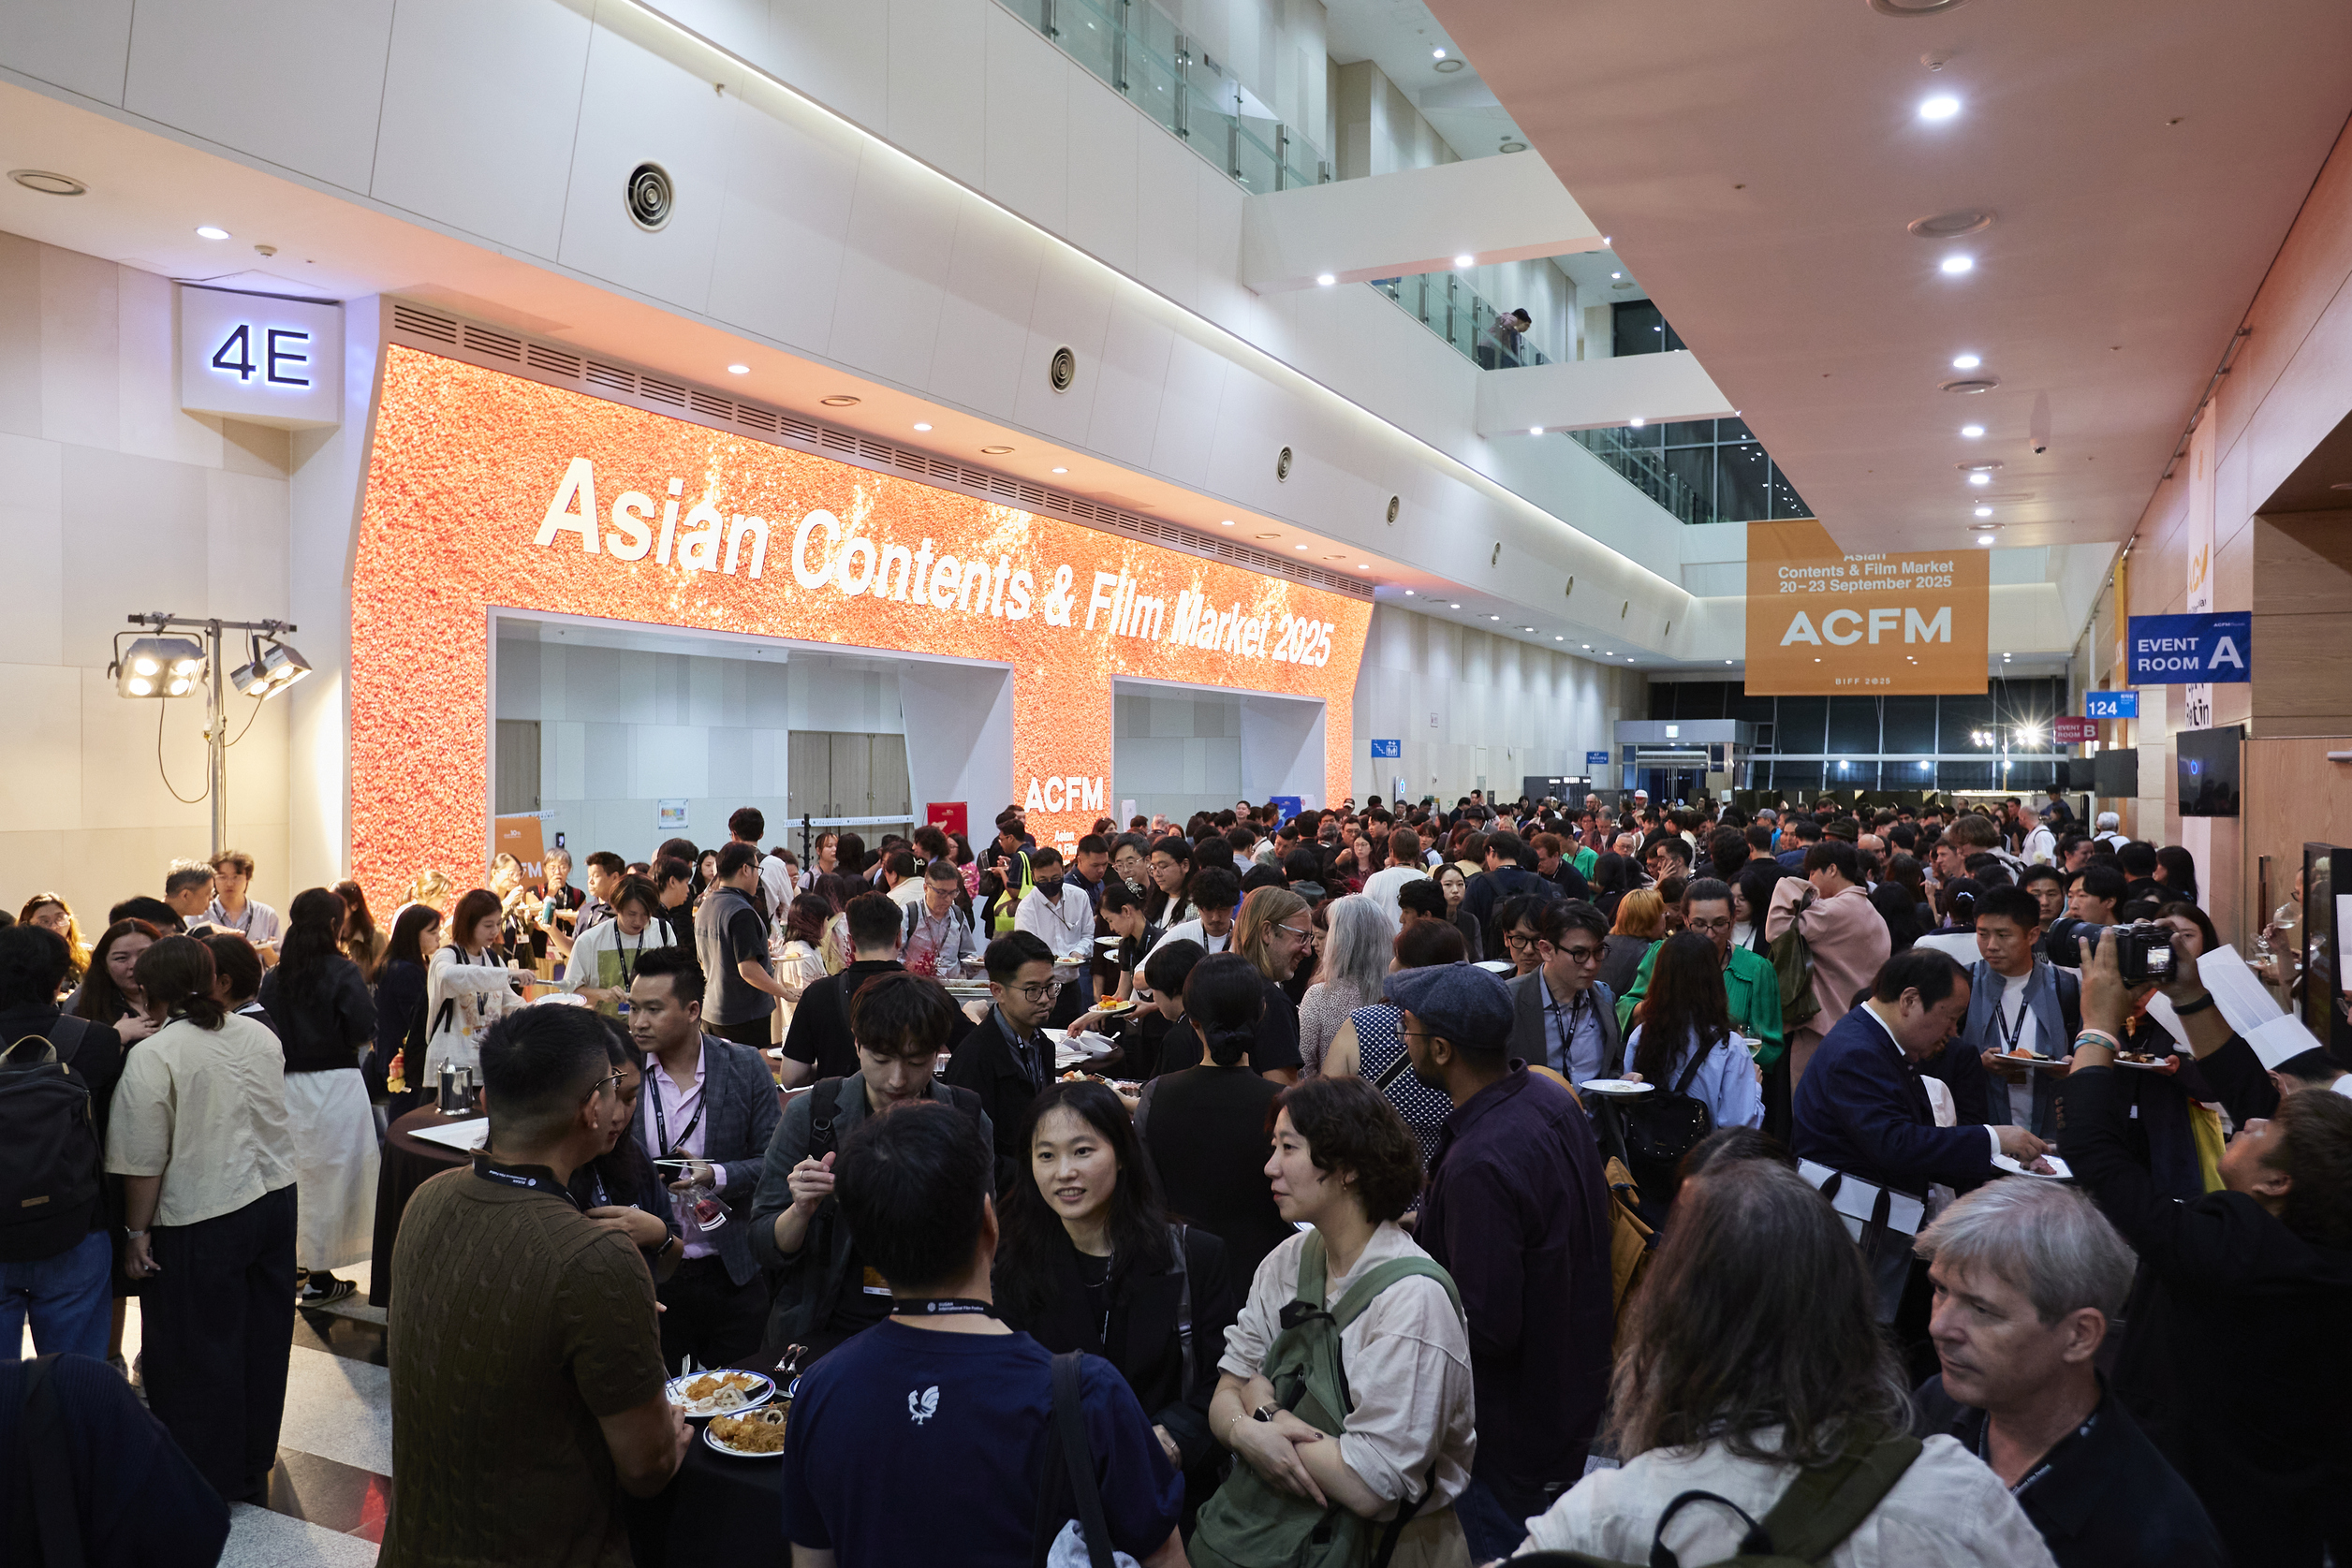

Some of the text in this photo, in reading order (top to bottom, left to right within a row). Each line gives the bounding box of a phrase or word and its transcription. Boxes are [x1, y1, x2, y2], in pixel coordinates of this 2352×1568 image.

[213, 324, 309, 386] 4E
[533, 457, 1334, 668] Asian Contents & Film Market 2025
[1778, 561, 1954, 579] Contents & Film Market
[1830, 577, 1911, 593] September
[1916, 576, 1952, 588] 2025
[1779, 607, 1951, 646] ACFM
[2138, 637, 2199, 652] EVENT
[2207, 636, 2244, 669] A
[2138, 656, 2199, 671] ROOM
[2089, 701, 2118, 715] 124
[2083, 725, 2095, 738] B
[1024, 776, 1104, 813] ACFM
[1054, 829, 1075, 842] Asian
